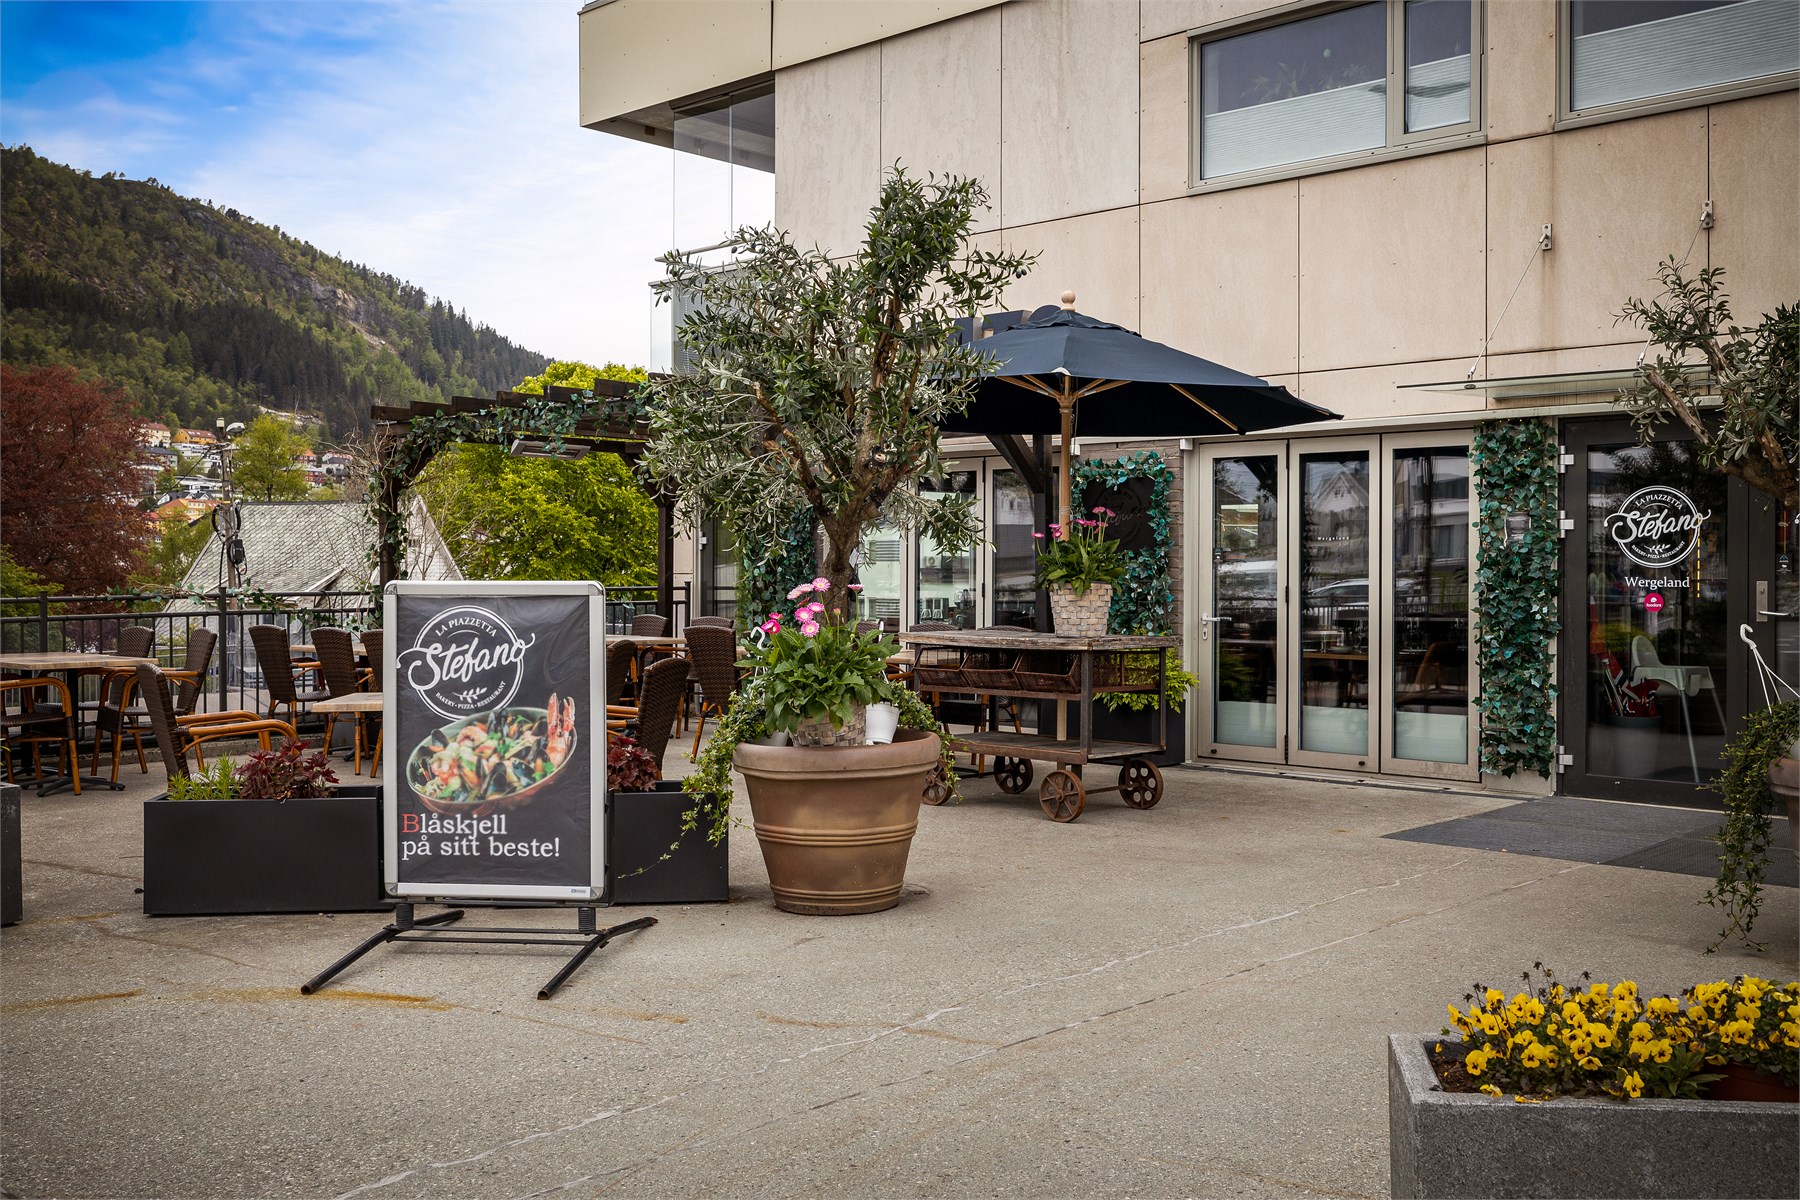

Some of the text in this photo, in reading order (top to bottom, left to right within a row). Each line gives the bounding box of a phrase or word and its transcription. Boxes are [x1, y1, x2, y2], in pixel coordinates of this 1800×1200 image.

[1635, 494, 1683, 510] LA PIAZZETTA
[1604, 508, 1712, 543] Stefano
[1624, 576, 1690, 590] Wergeland
[435, 616, 497, 637] LA PIAZZETTA
[396, 633, 535, 690] Stefano
[435, 691, 456, 708] BAKERY
[477, 680, 507, 708] RESTAURANT
[401, 813, 508, 840] Blåskjell
[401, 835, 560, 861] på sitt beste!
